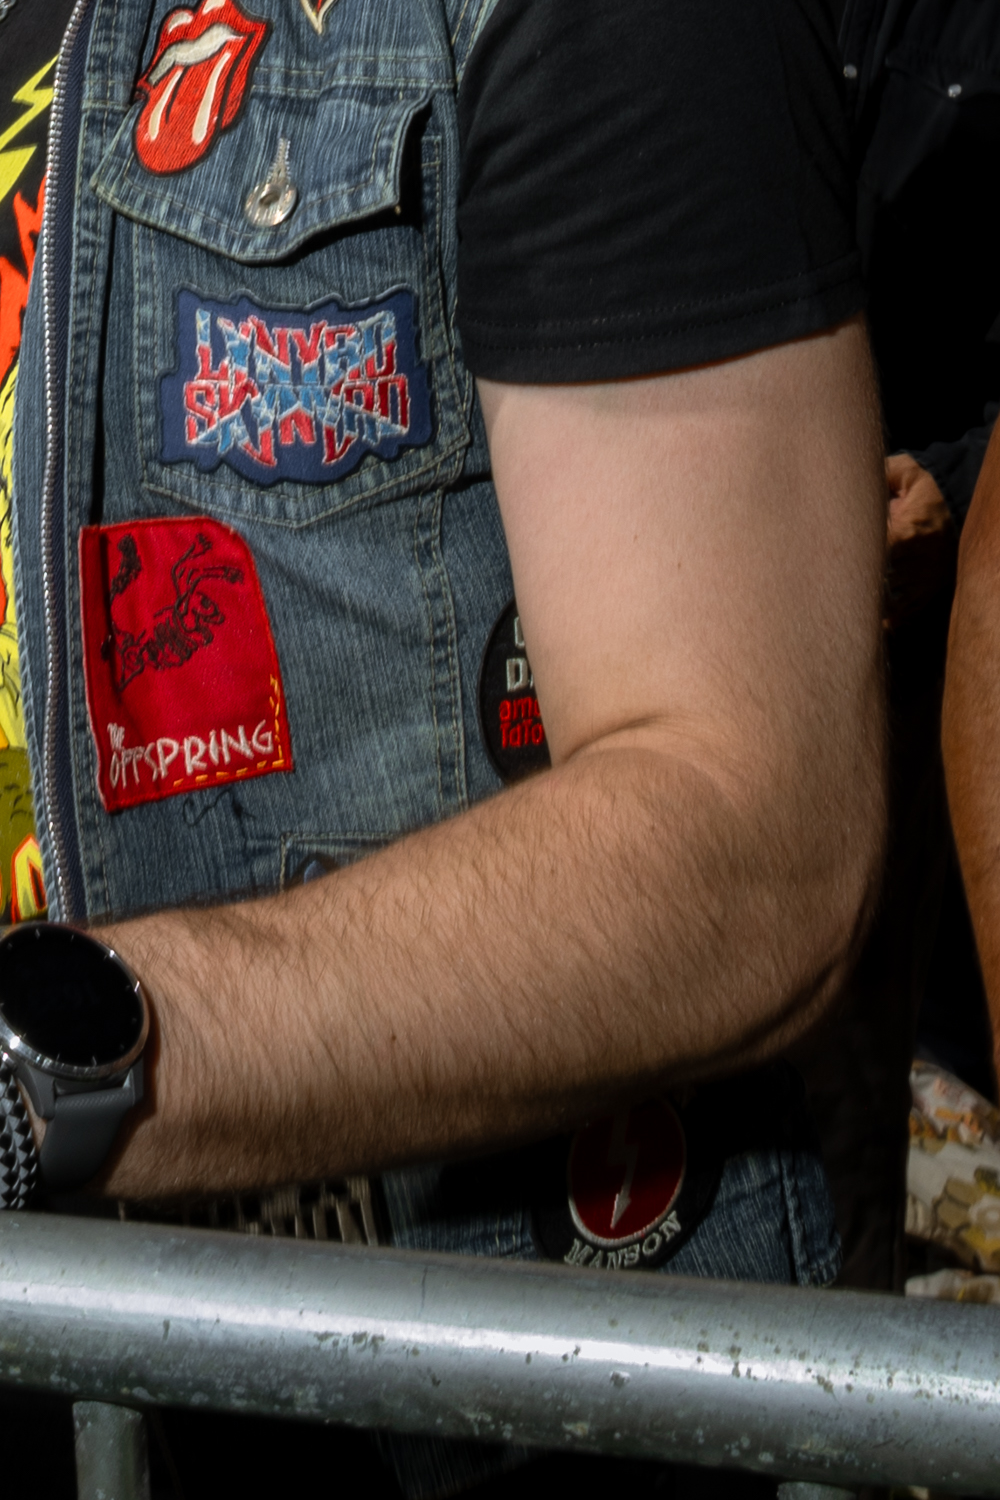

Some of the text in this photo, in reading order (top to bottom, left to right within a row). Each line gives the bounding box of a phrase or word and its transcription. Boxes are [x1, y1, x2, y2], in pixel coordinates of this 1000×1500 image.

[195, 308, 397, 386] LYNYRD
[184, 376, 410, 467] SKYNYRD
[109, 719, 275, 790] OFFSPRING
[563, 1210, 681, 1270] MANSON
